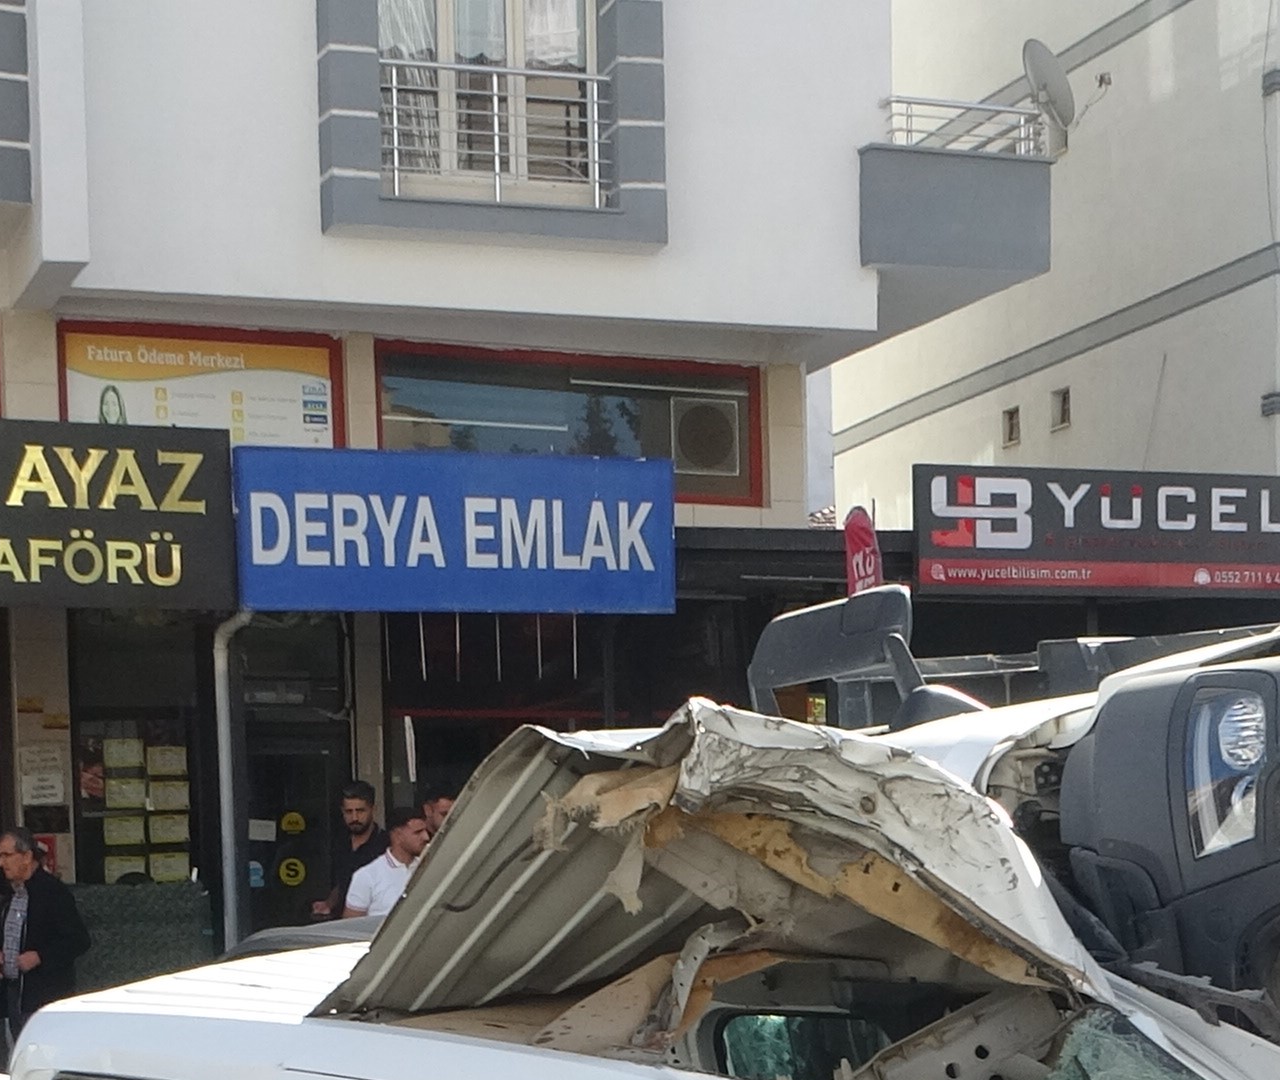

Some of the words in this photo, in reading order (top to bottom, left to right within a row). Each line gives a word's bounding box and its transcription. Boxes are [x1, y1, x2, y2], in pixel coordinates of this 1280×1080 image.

[86, 345, 133, 363] Fatura
[137, 345, 184, 366] Ödeme
[189, 351, 246, 369] Merkezi
[6, 444, 207, 515] AYAZ
[250, 492, 446, 569] DERYA
[464, 497, 656, 571] EMLAK
[947, 565, 1092, 581] www.yucelbilisim.com.tr
[1214, 570, 1241, 584] 0552
[1243, 571, 1262, 584] 711
[1265, 572, 1273, 585] 6
